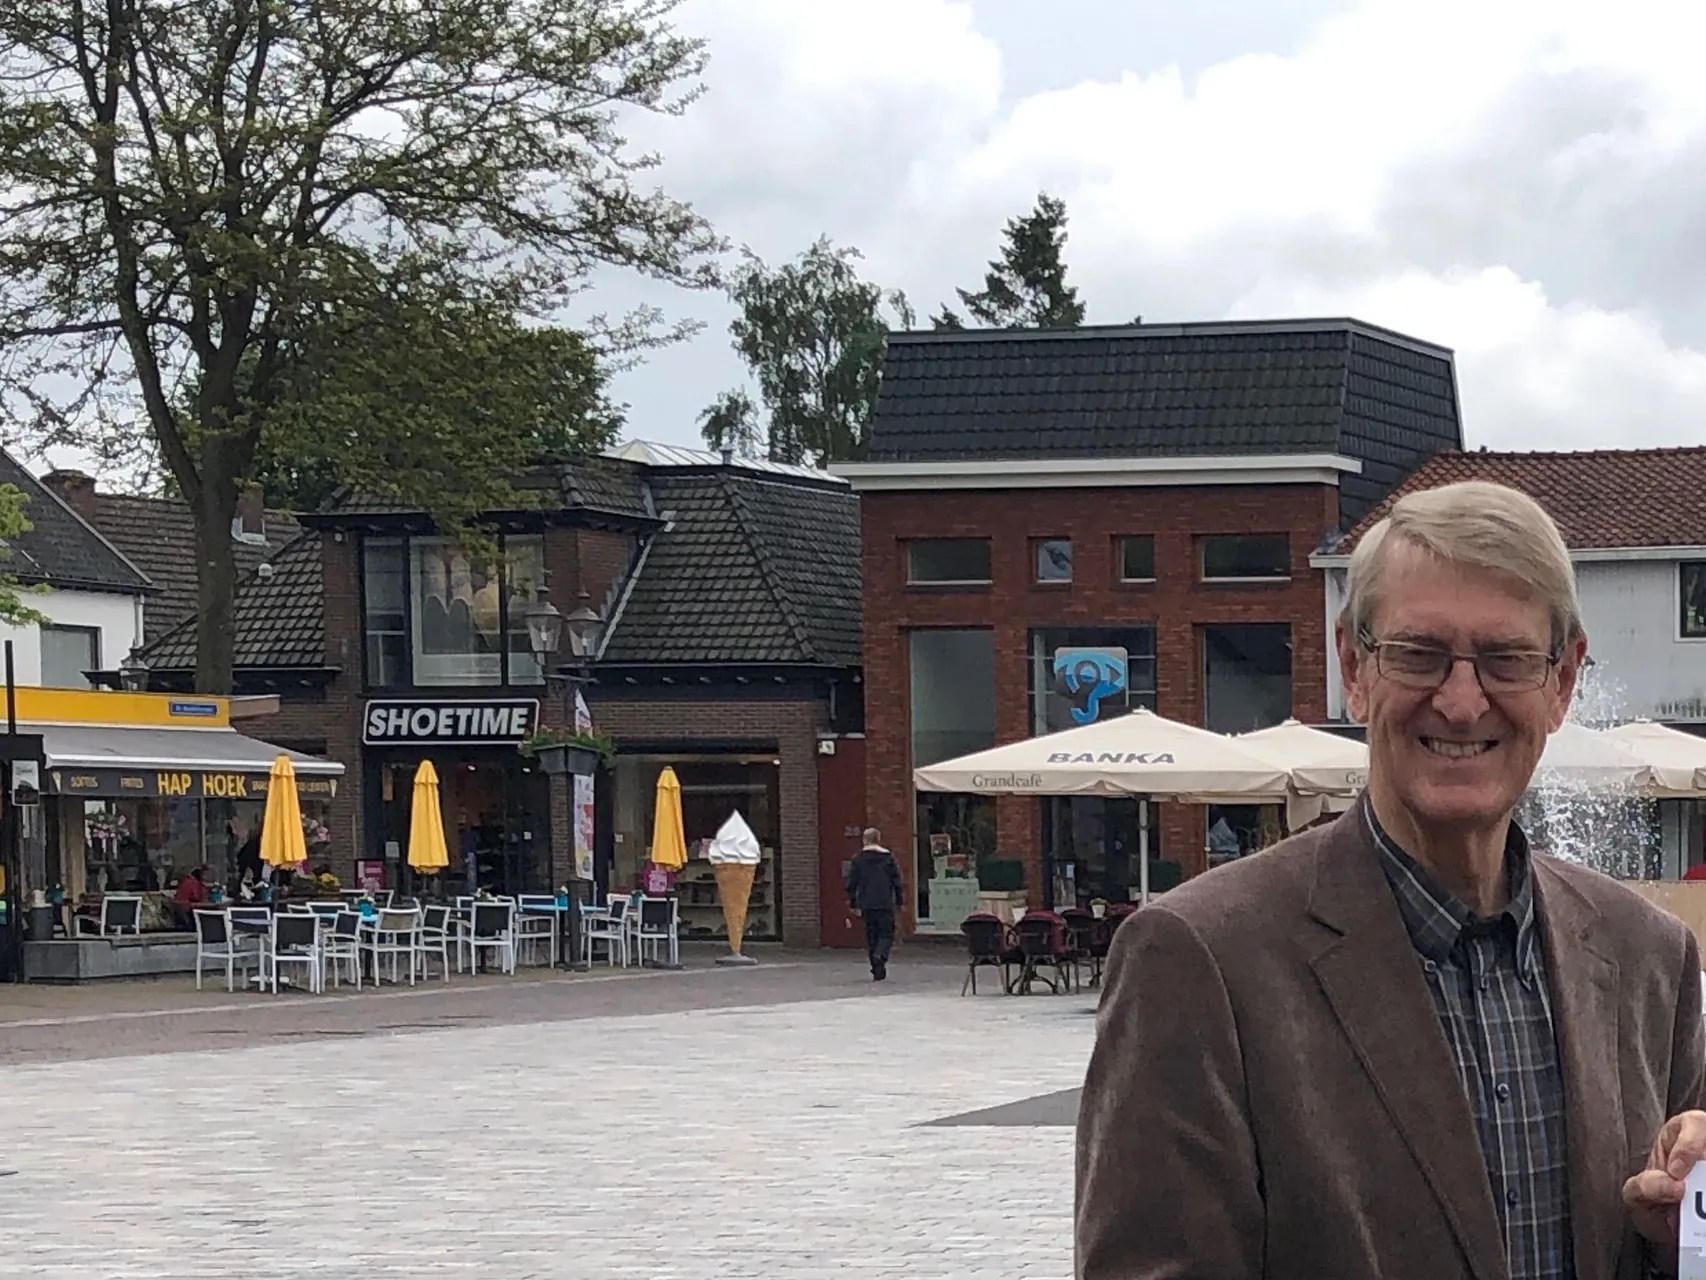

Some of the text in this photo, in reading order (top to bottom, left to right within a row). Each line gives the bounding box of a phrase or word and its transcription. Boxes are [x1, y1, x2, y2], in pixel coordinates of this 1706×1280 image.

[367, 707, 530, 737] SHOETIME
[1045, 752, 1176, 765] BANKA
[157, 772, 192, 796] HAP
[202, 773, 248, 797] HOEK
[972, 773, 1043, 788] Grandcafé
